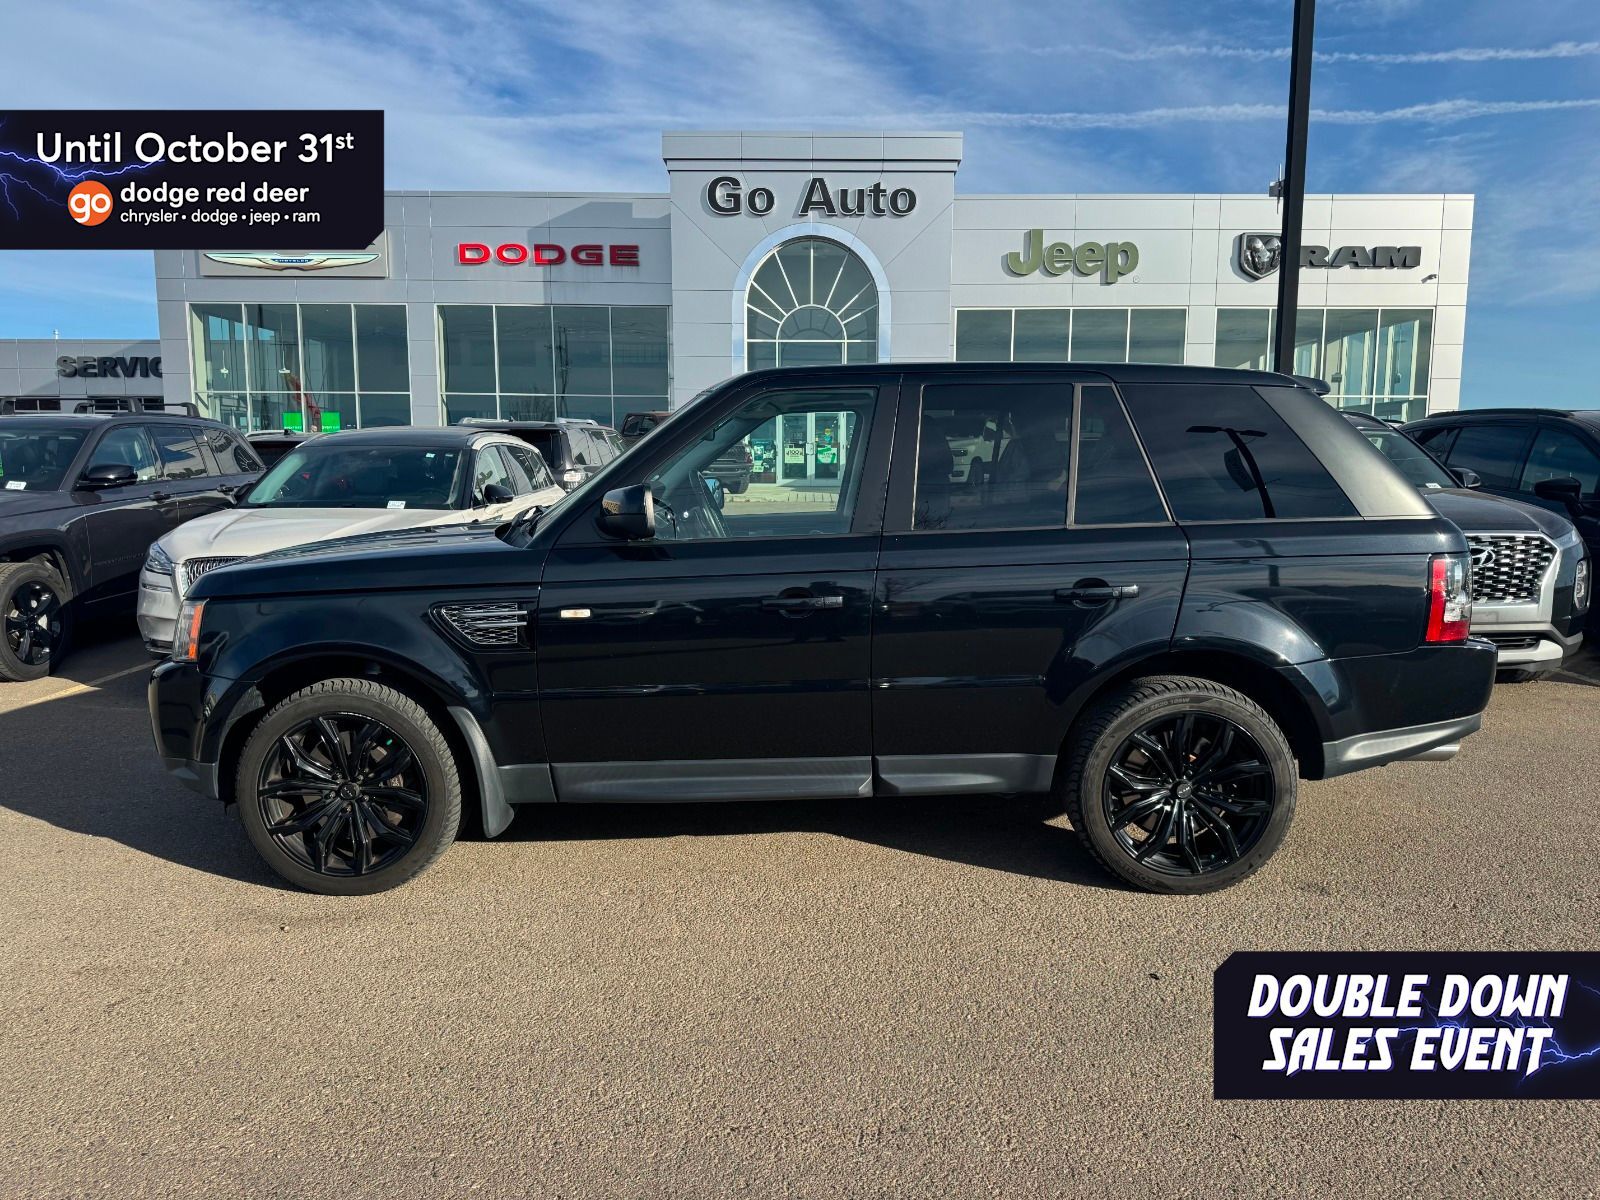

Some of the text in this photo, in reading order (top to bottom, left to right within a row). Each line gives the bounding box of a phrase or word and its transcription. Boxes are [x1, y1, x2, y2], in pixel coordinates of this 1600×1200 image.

[707, 176, 917, 216] Go Auto
[458, 243, 640, 267] DODGE
[1007, 229, 1139, 283] Jeep
[1299, 245, 1422, 267] RAM
